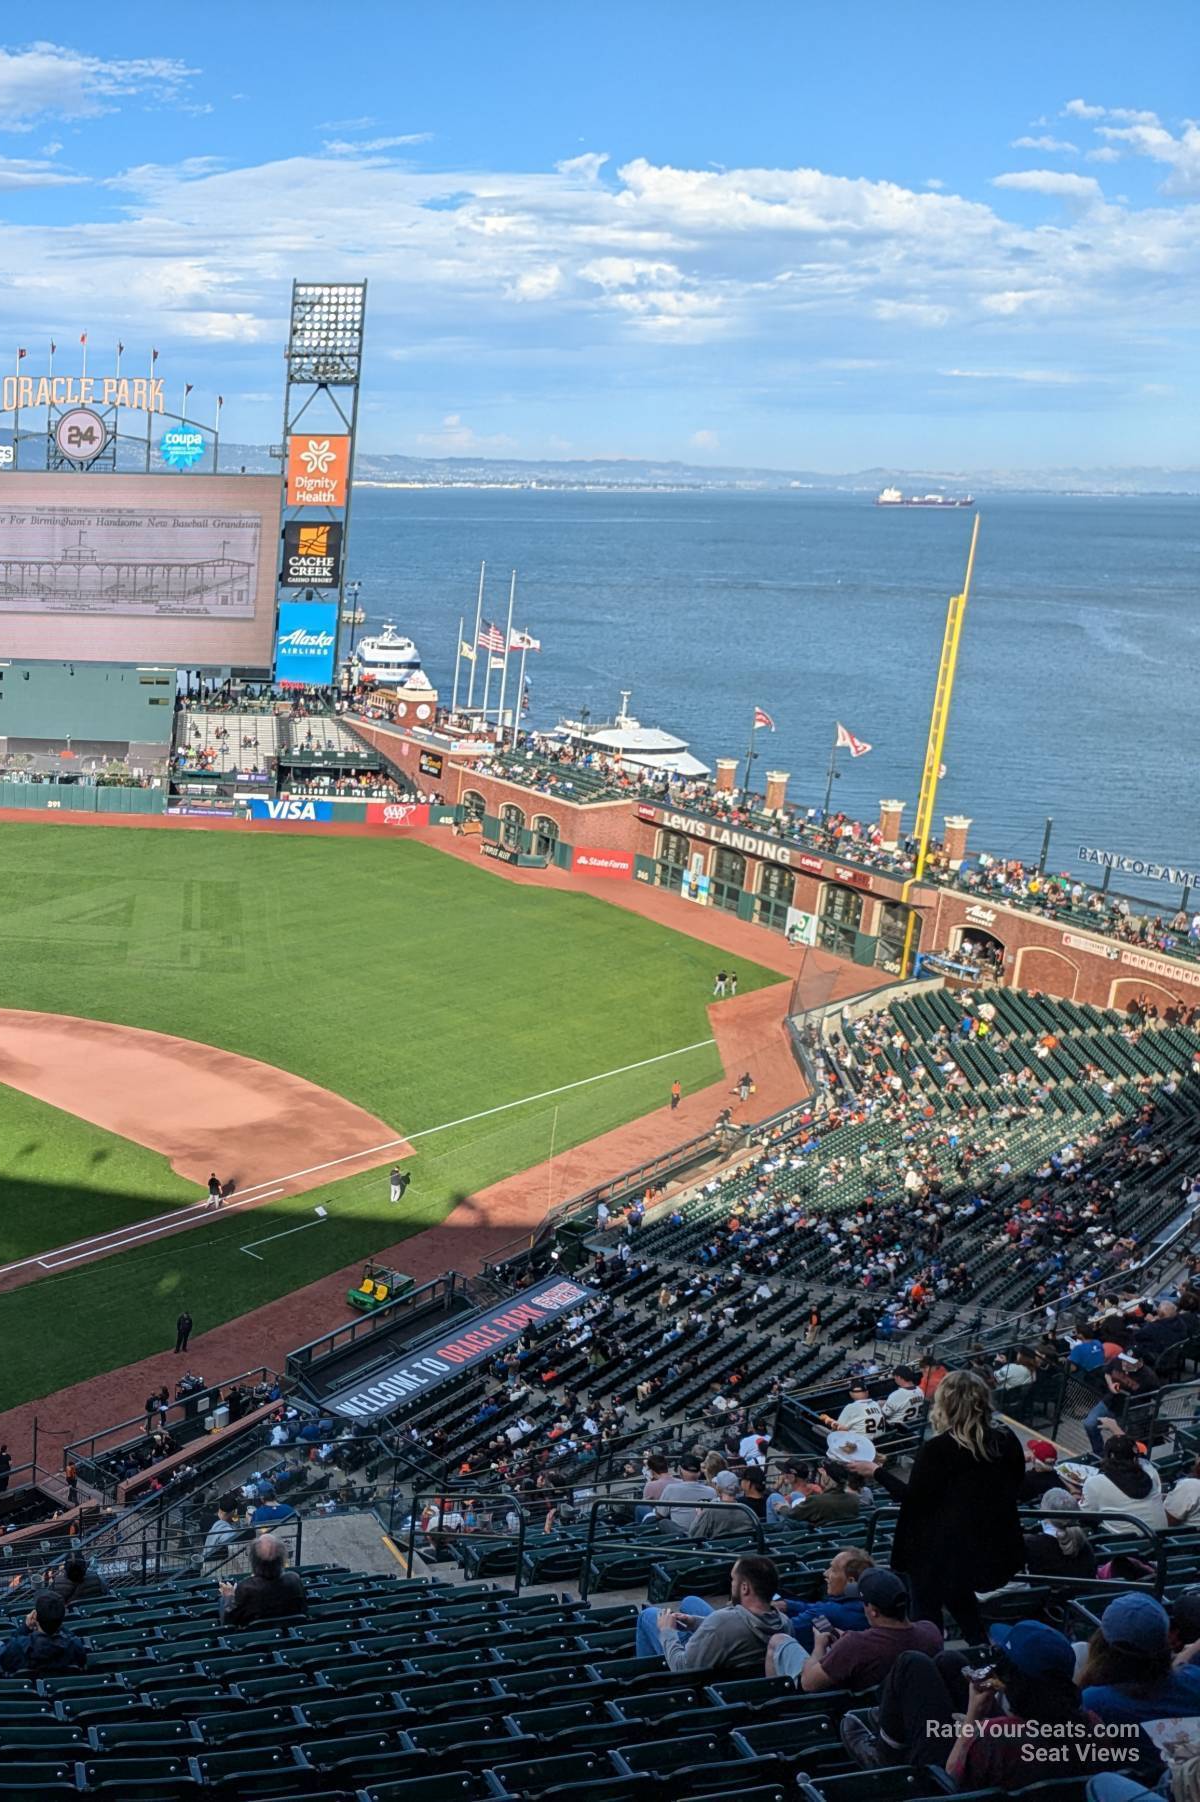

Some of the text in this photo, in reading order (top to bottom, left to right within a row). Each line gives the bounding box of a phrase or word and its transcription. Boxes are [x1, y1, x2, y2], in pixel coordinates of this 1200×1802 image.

[2, 376, 165, 414] ORACLE PARK
[68, 426, 99, 448] 24
[165, 434, 202, 448] coupa
[295, 477, 338, 491] Dignity
[296, 491, 336, 503] Health
[10, 515, 25, 525] For
[30, 516, 91, 527] Birmingham's
[96, 517, 143, 527] Handsome
[147, 517, 168, 527] New
[172, 519, 209, 528] Baseball
[289, 557, 335, 567] CACHE
[289, 567, 332, 577] CREEK
[279, 629, 335, 647] Alaska
[281, 648, 328, 656] AIRLINES
[264, 800, 316, 820] VISA
[709, 826, 791, 865] LANDING
[589, 856, 630, 870] State Farm
[1079, 846, 1126, 870] BANK
[1132, 860, 1156, 876] OF
[883, 960, 901, 974] 309
[335, 1303, 548, 1417] WELCOME TO ORACLE PARK
[865, 1417, 886, 1434] 24
